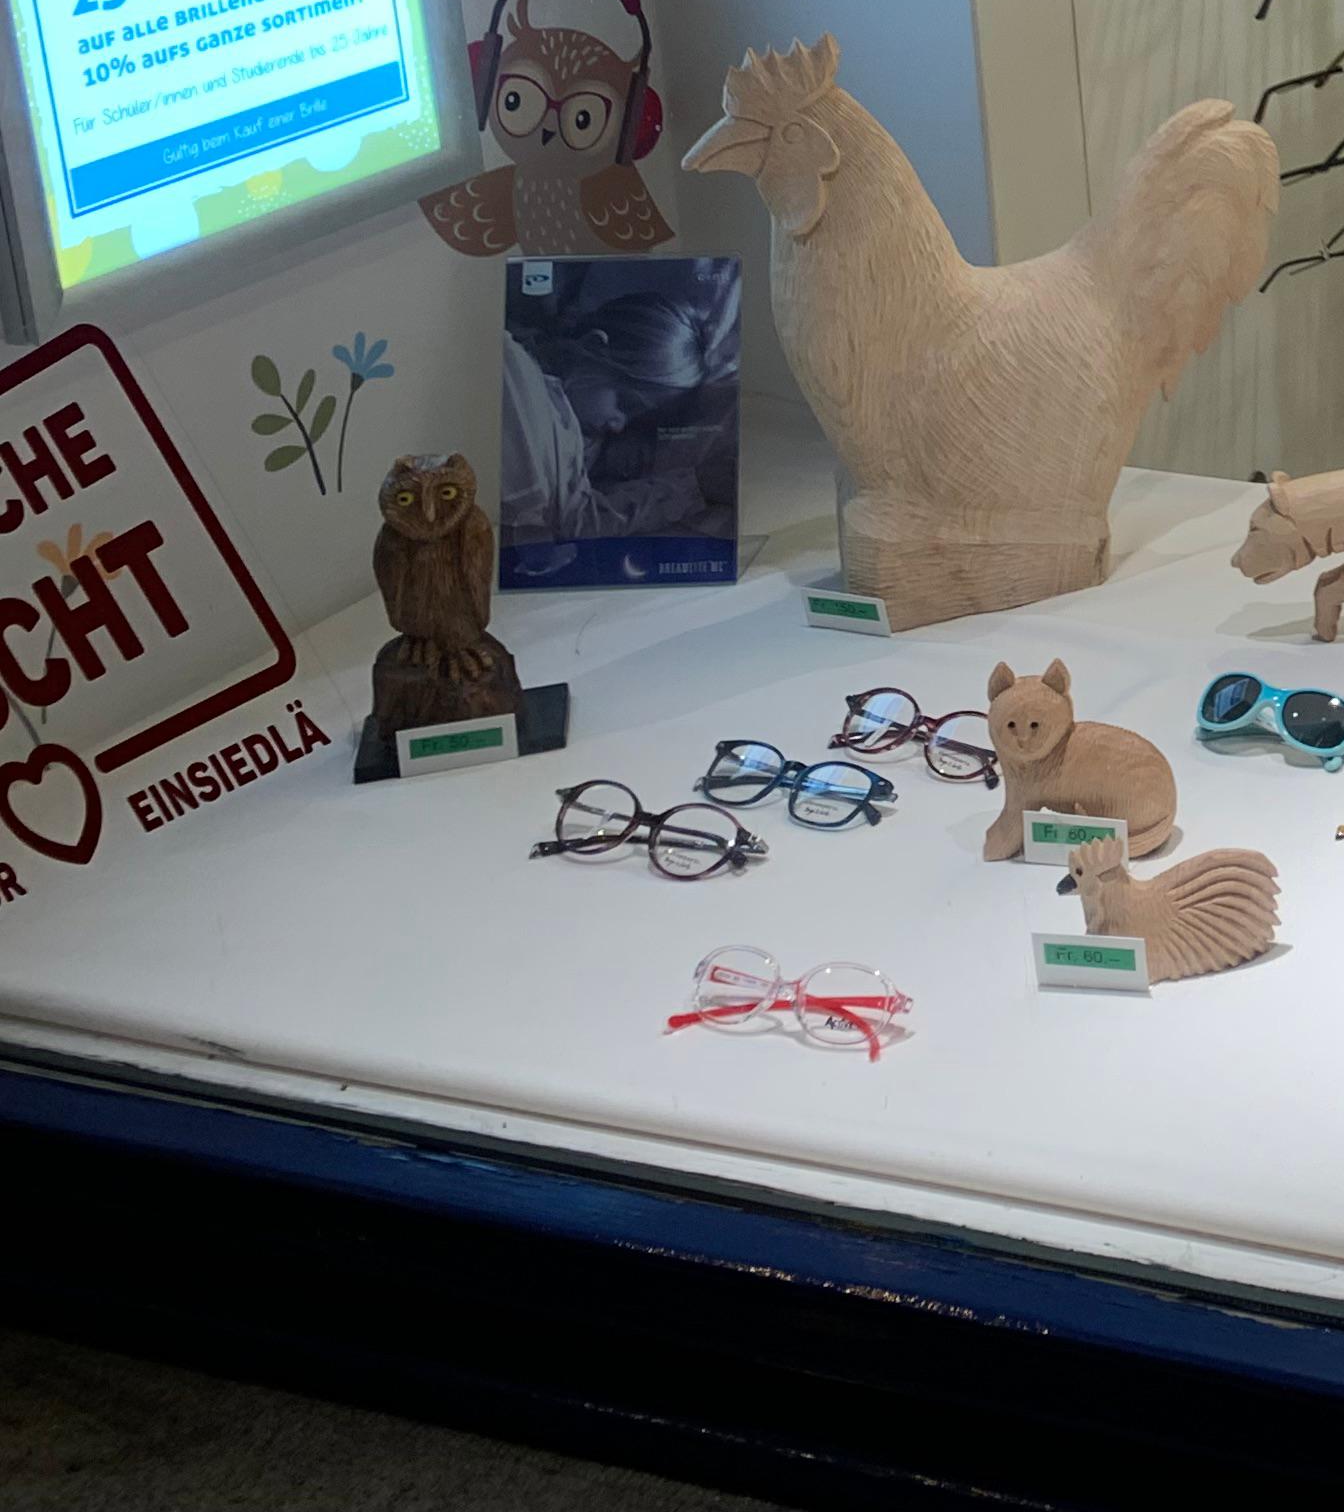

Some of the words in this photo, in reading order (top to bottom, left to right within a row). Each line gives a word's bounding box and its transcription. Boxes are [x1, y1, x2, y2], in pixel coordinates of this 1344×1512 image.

[72, 117, 97, 136] Für
[102, 84, 199, 126] Schüler/innen
[203, 73, 227, 95] und
[231, 51, 305, 85] Studierende
[310, 42, 327, 59] bis
[352, 22, 389, 45] Jahre
[83, 53, 137, 88] 10%
[202, 127, 231, 152] beim
[233, 117, 264, 140] Kauf
[267, 109, 296, 129] einer
[299, 97, 329, 120] Brille
[126, 699, 333, 833] EINSIEDLÄ
